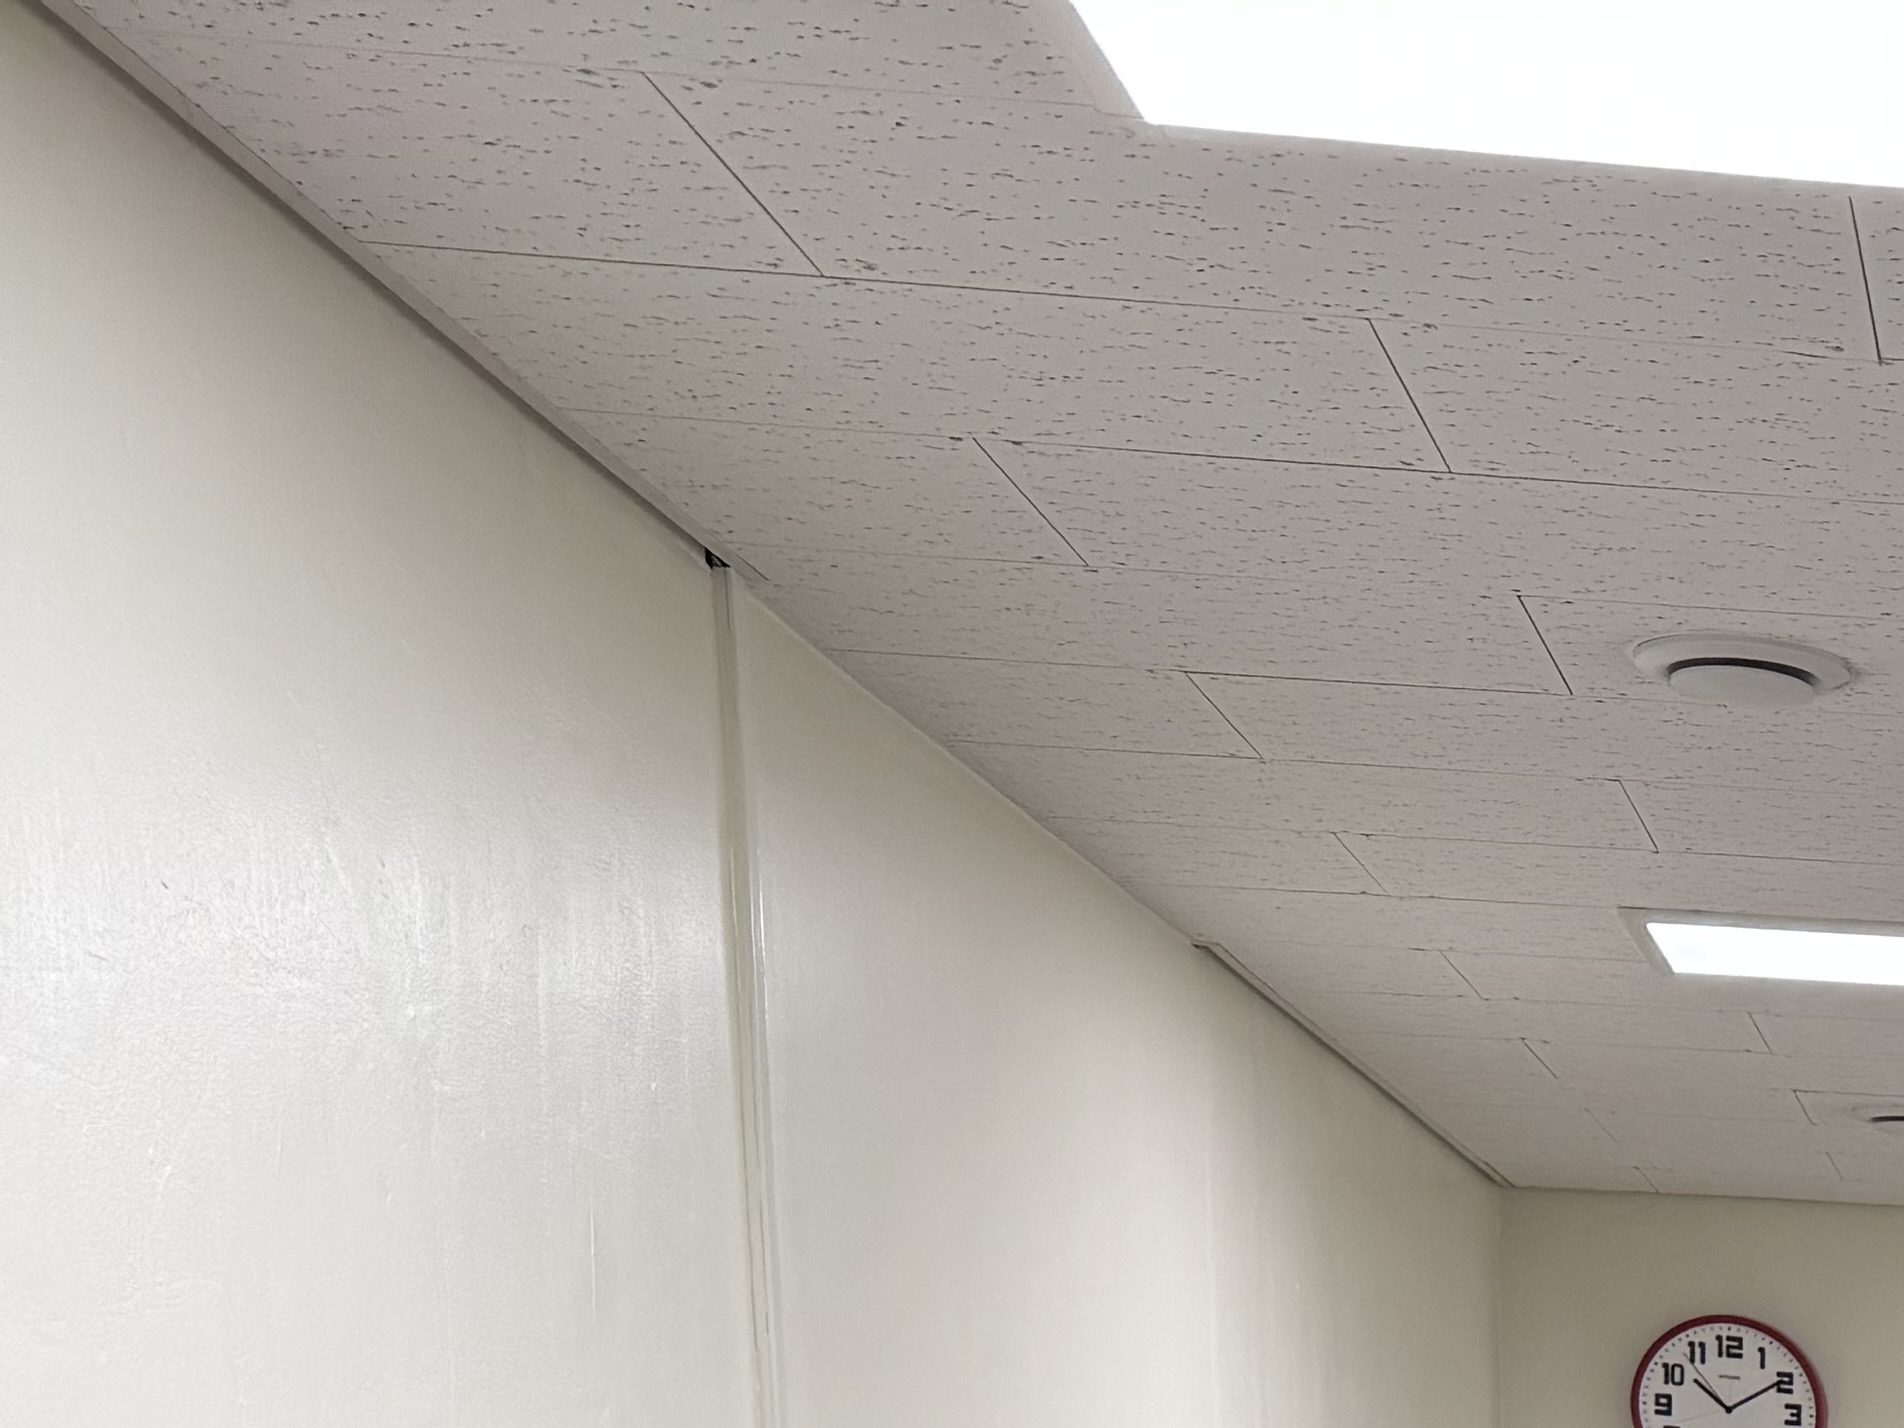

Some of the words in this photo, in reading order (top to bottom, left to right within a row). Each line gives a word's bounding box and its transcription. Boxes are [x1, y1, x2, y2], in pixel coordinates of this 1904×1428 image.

[1687, 1341, 1706, 1364] 11
[1715, 1334, 1744, 1359] 12
[1758, 1347, 1766, 1369] 1
[1662, 1362, 1685, 1386] 10
[1776, 1371, 1794, 1395] 2
[1654, 1393, 1673, 1416] 9
[1784, 1403, 1802, 1426] 3
